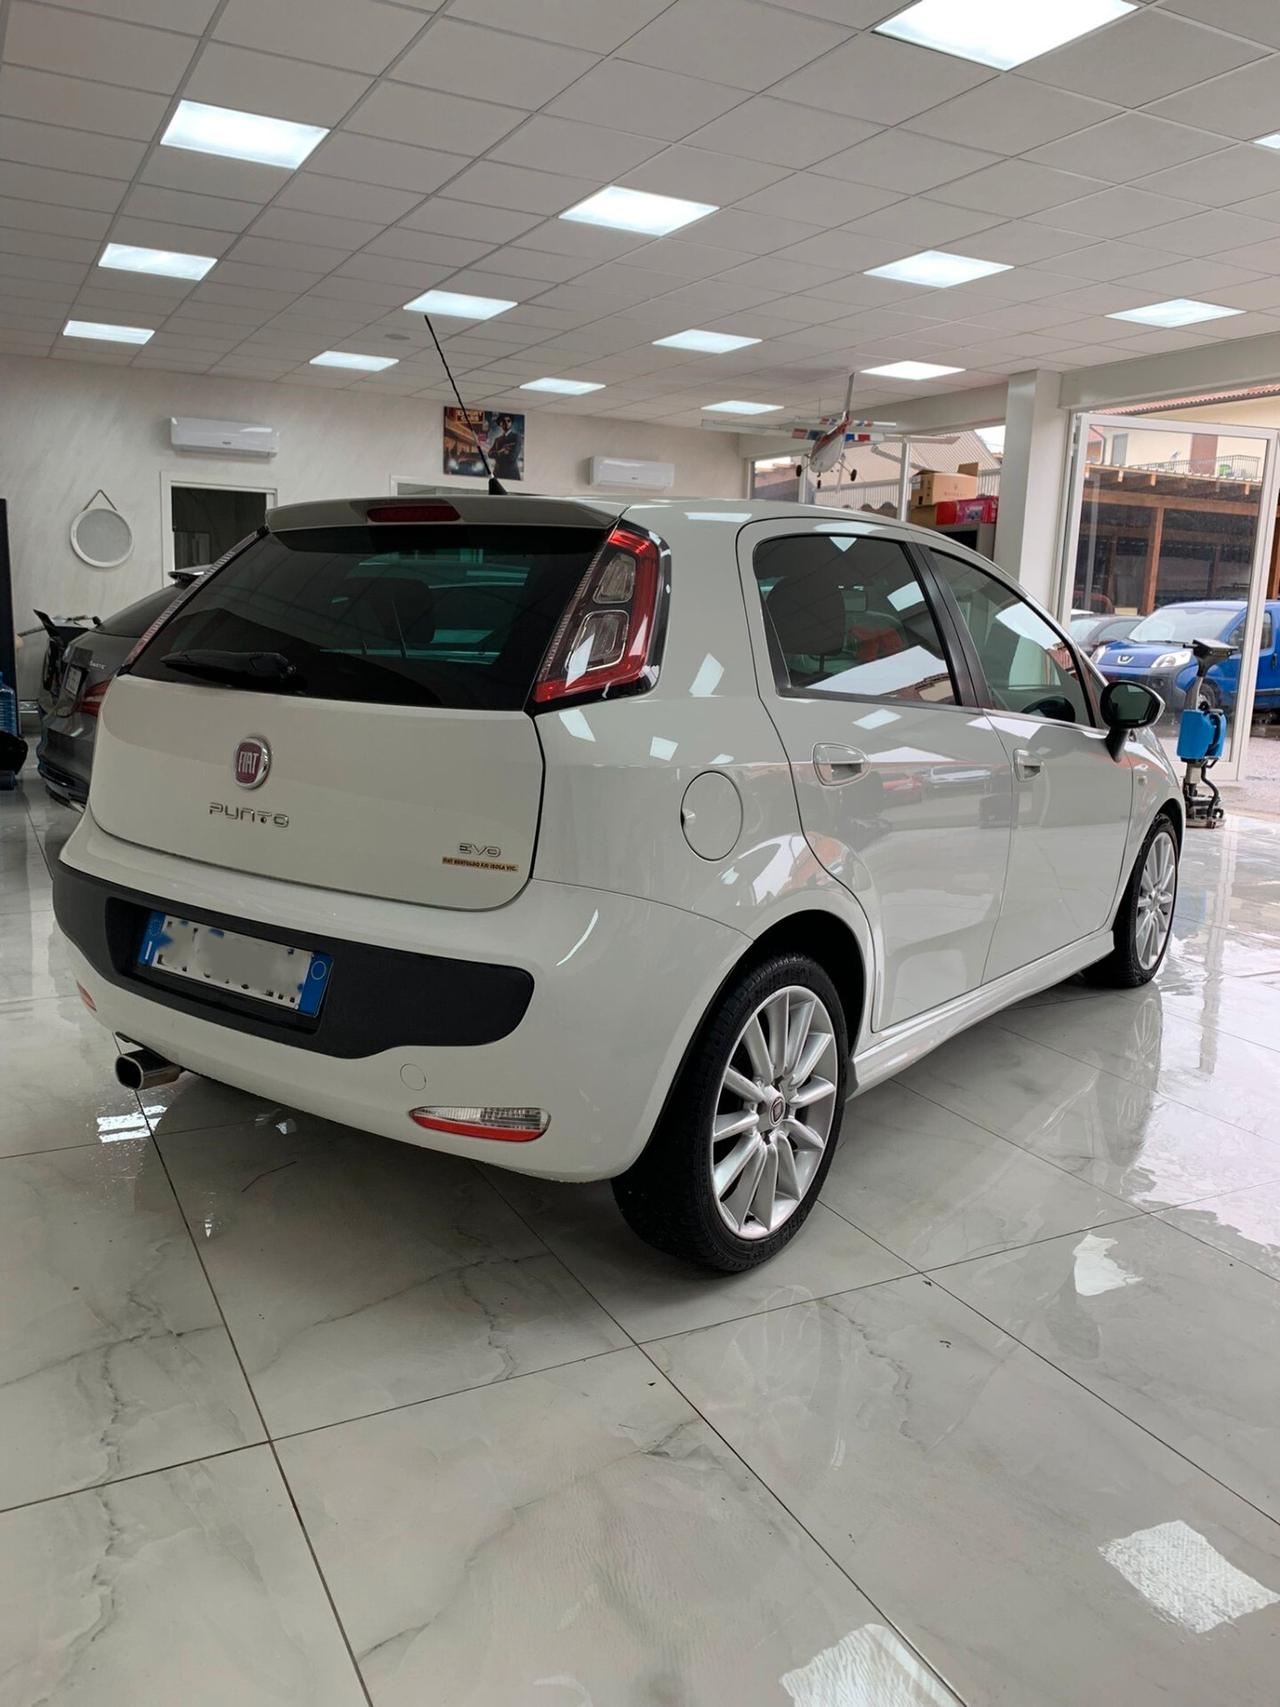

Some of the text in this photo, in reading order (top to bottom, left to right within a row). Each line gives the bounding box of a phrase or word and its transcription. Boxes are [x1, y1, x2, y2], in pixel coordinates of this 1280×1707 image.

[238, 751, 260, 774] FIAT
[209, 801, 289, 828] PUNTO
[459, 843, 501, 857] EVO
